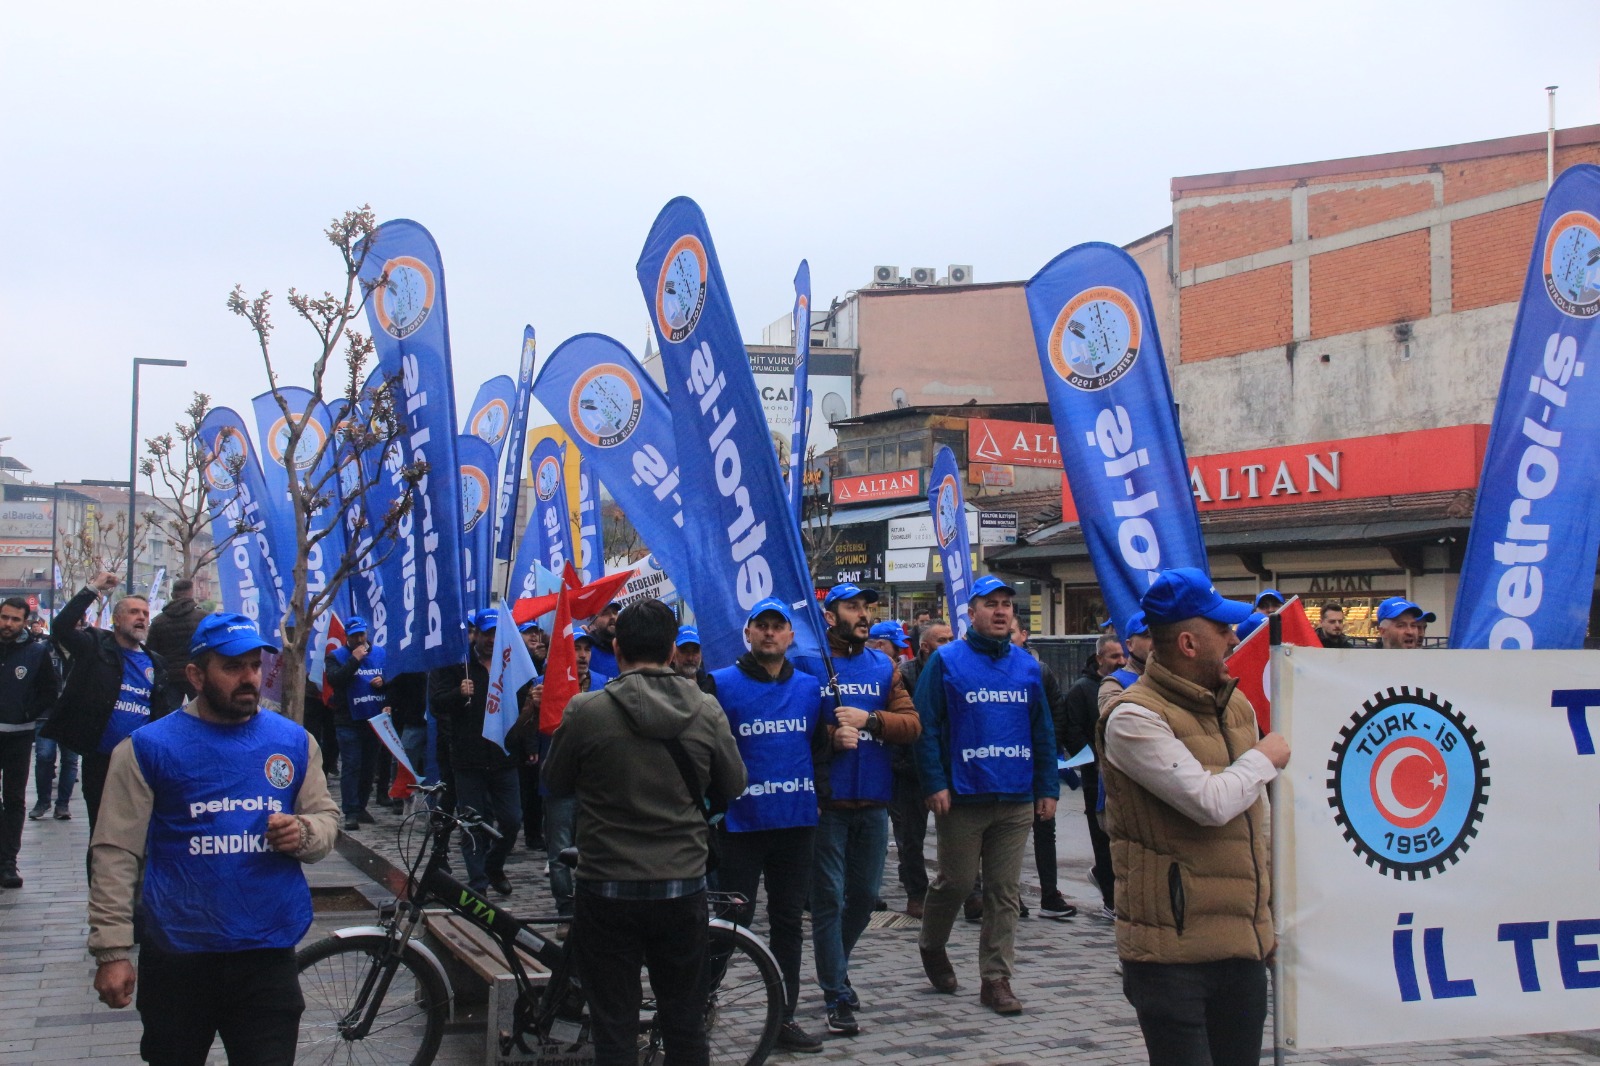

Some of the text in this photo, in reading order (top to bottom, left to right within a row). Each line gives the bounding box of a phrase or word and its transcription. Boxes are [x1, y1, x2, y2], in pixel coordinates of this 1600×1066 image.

[749, 355, 766, 364] HİT
[858, 474, 914, 494] ALTAN
[1191, 451, 1343, 503] ALTAN
[1308, 575, 1373, 593] ALTAN
[965, 688, 1028, 704] GÖREVLİ
[738, 716, 807, 737] GÖREVLİ
[962, 744, 1031, 762] petrol-iş
[190, 796, 282, 818] petrol-iş
[188, 829, 274, 856] SENDİKA
[1383, 826, 1445, 855] 1952
[1392, 912, 1600, 1003] İL TE
